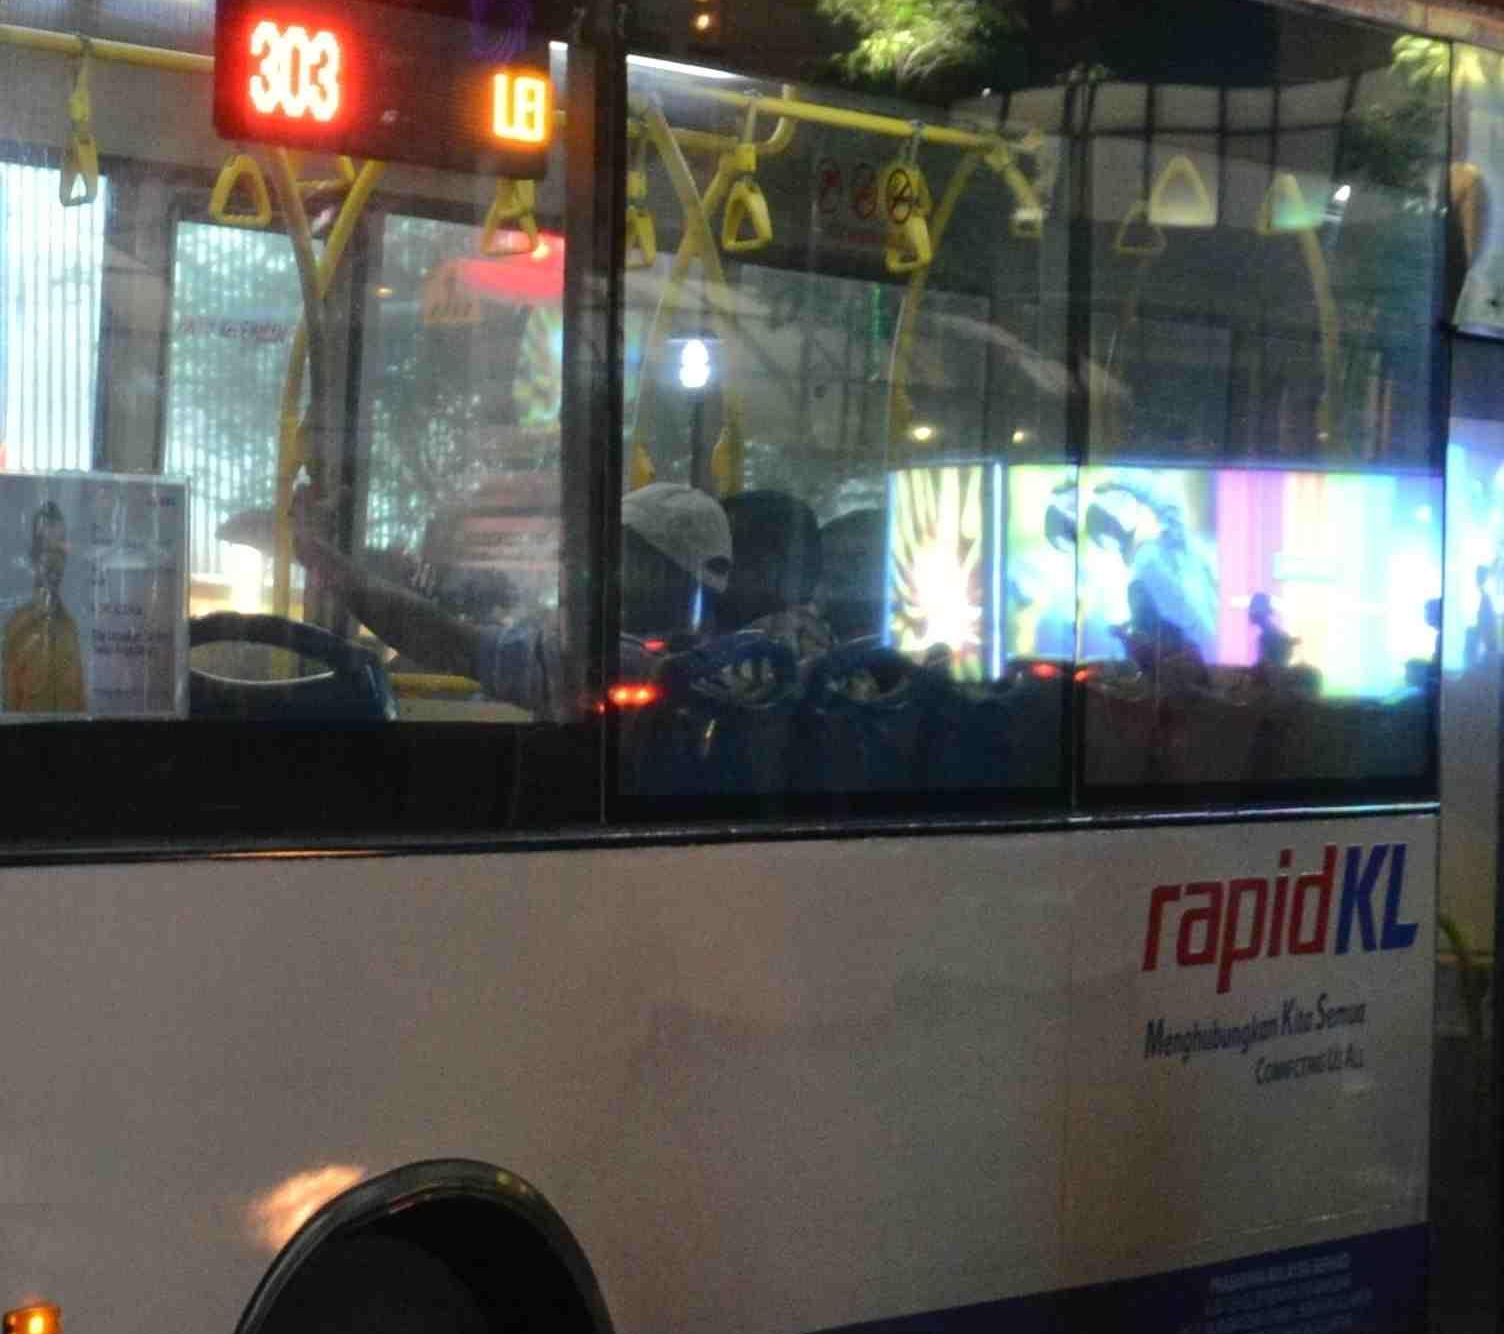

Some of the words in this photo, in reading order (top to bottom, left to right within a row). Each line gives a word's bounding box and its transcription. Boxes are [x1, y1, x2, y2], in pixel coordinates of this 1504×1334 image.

[248, 19, 342, 123] 303
[1141, 842, 1419, 994] rapidKL
[1316, 993, 1367, 1030] Semua
